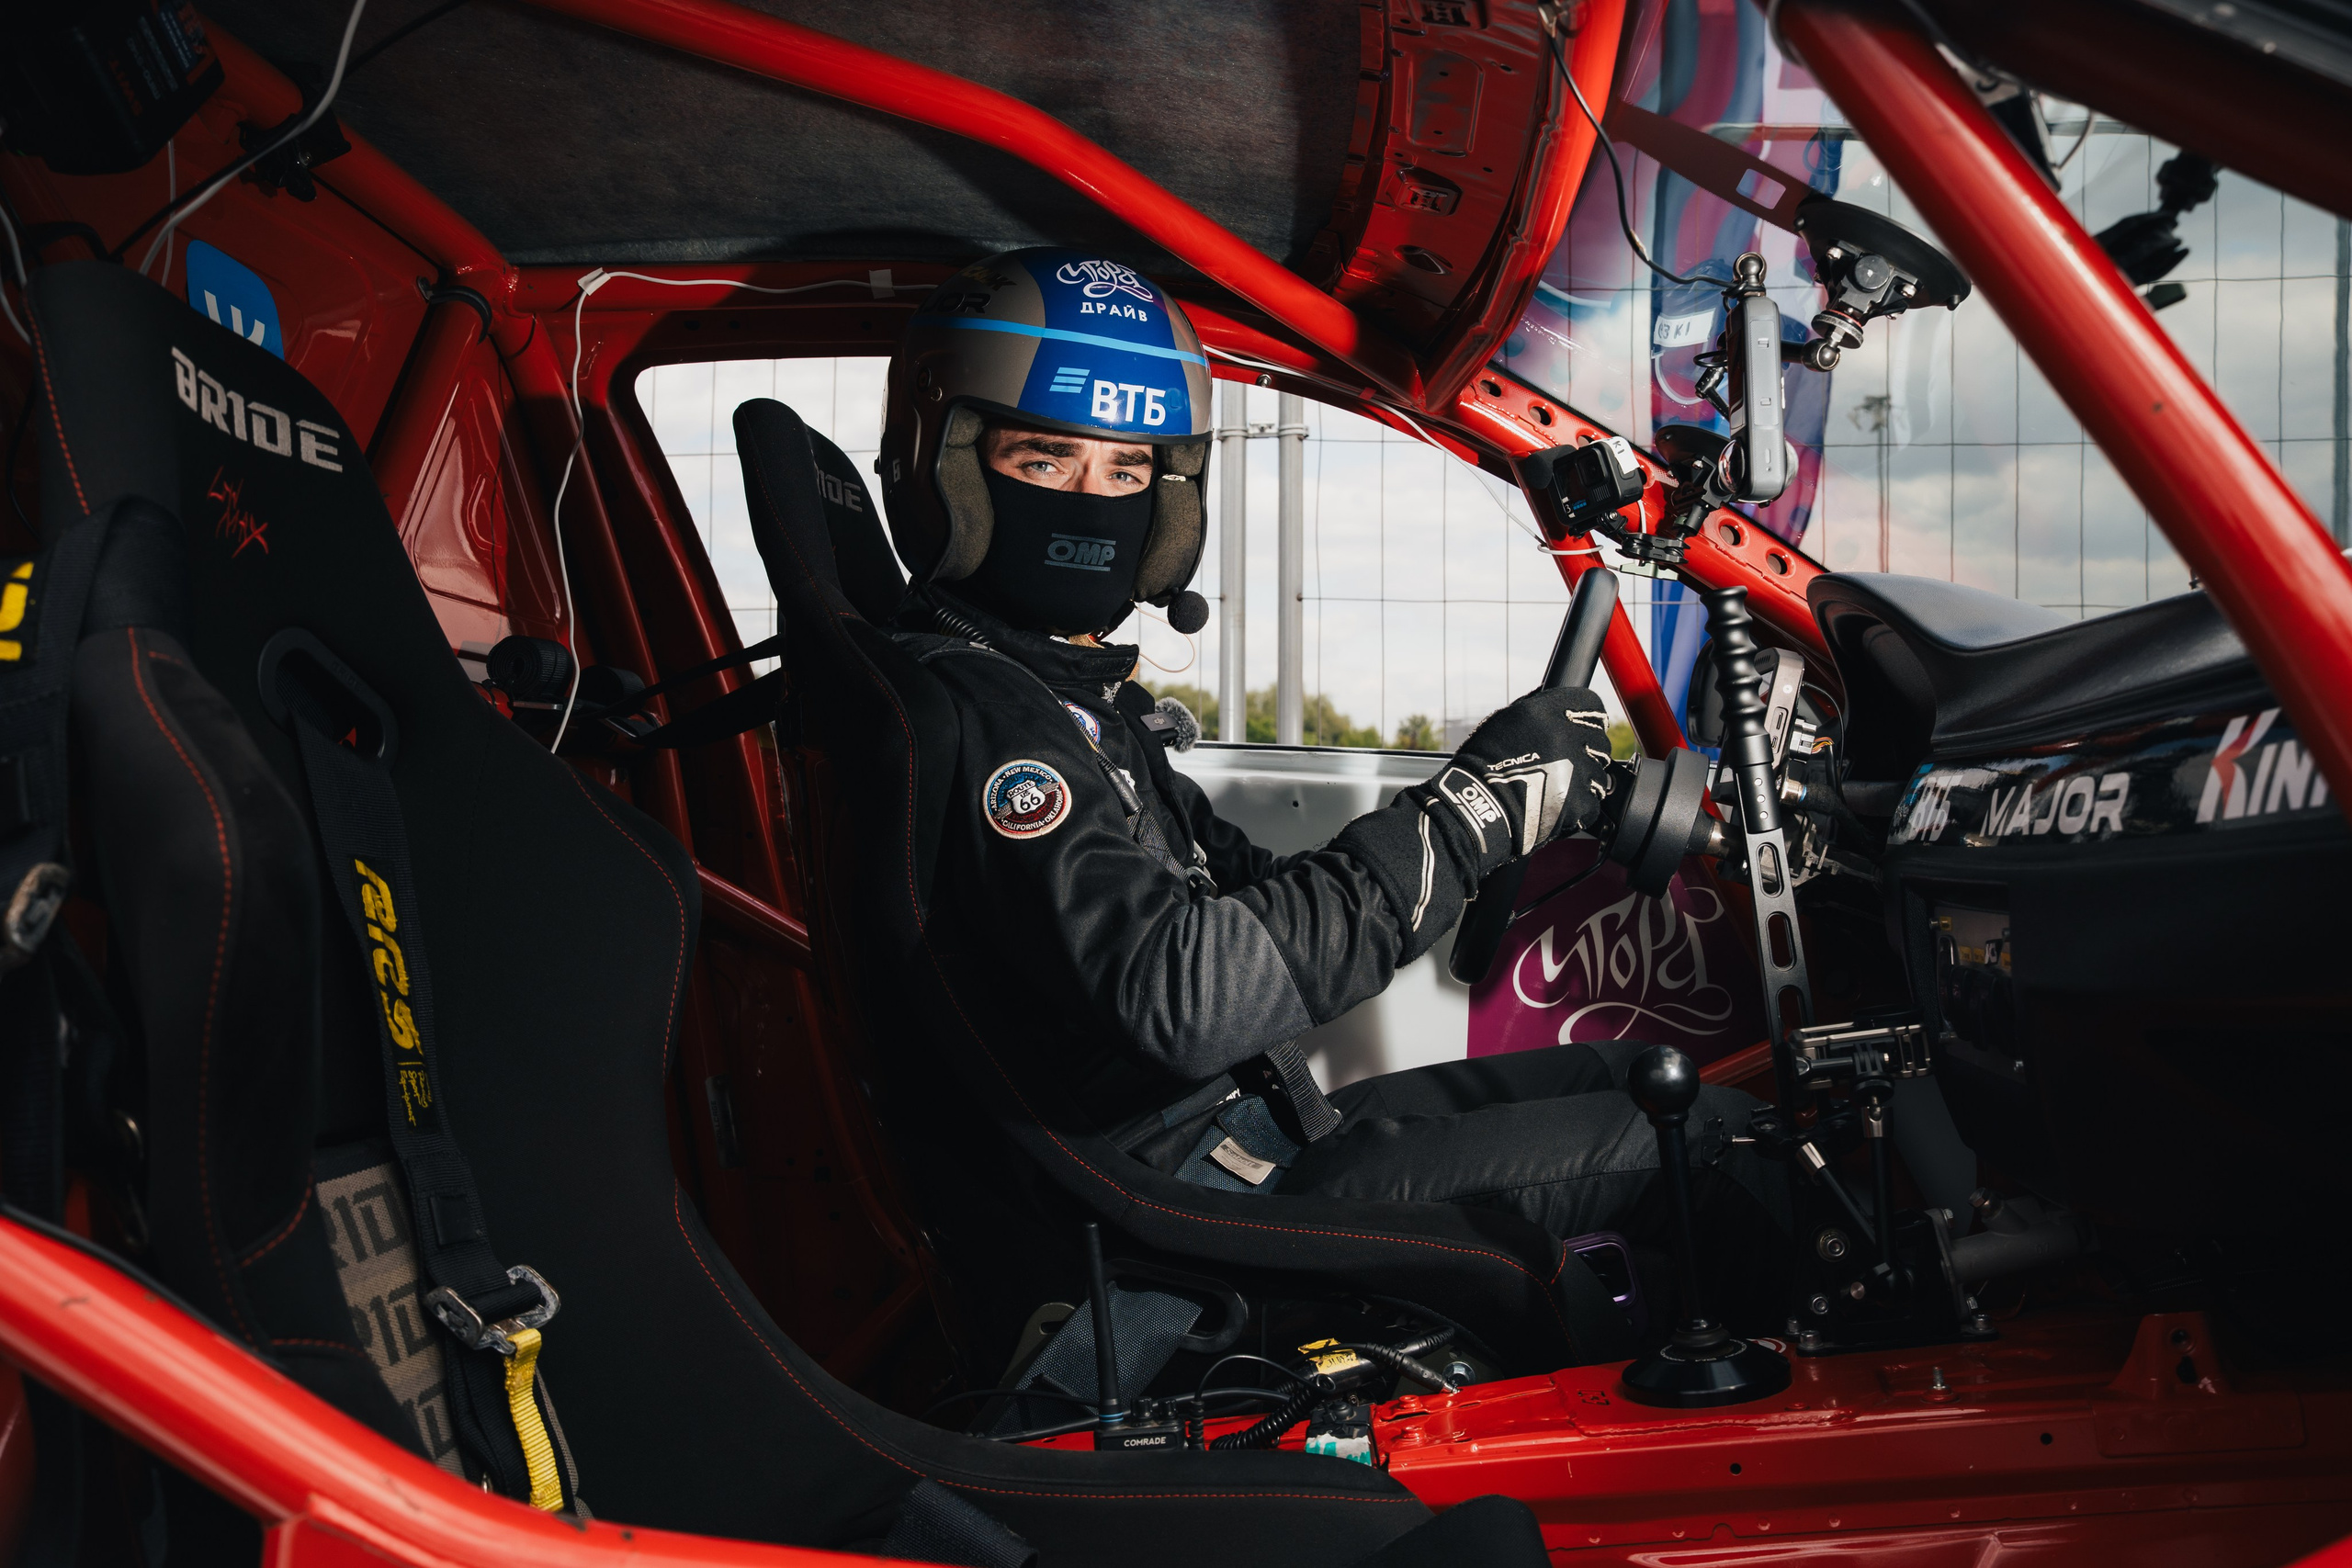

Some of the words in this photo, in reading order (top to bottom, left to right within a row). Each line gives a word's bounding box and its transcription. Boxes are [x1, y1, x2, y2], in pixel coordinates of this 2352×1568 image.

[1080, 301, 1148, 322] ДРАЙВ
[171, 345, 344, 474] BRIDE
[1091, 378, 1167, 427] ВТБ
[814, 461, 863, 513] IDE
[1047, 539, 1115, 566] OMP
[1487, 751, 1541, 772] TECNICA
[989, 777, 1005, 809] ARIZONA
[1004, 766, 1022, 778] NEW
[1023, 765, 1052, 781] MEXICO
[1007, 782, 1035, 798] ROUTE
[1020, 793, 1041, 811] 66
[1462, 786, 1497, 823] OMP
[1980, 772, 2131, 838] MAJOR
[1001, 819, 1045, 831] CALIFORNIA
[1123, 1436, 1167, 1448] COMRADE
